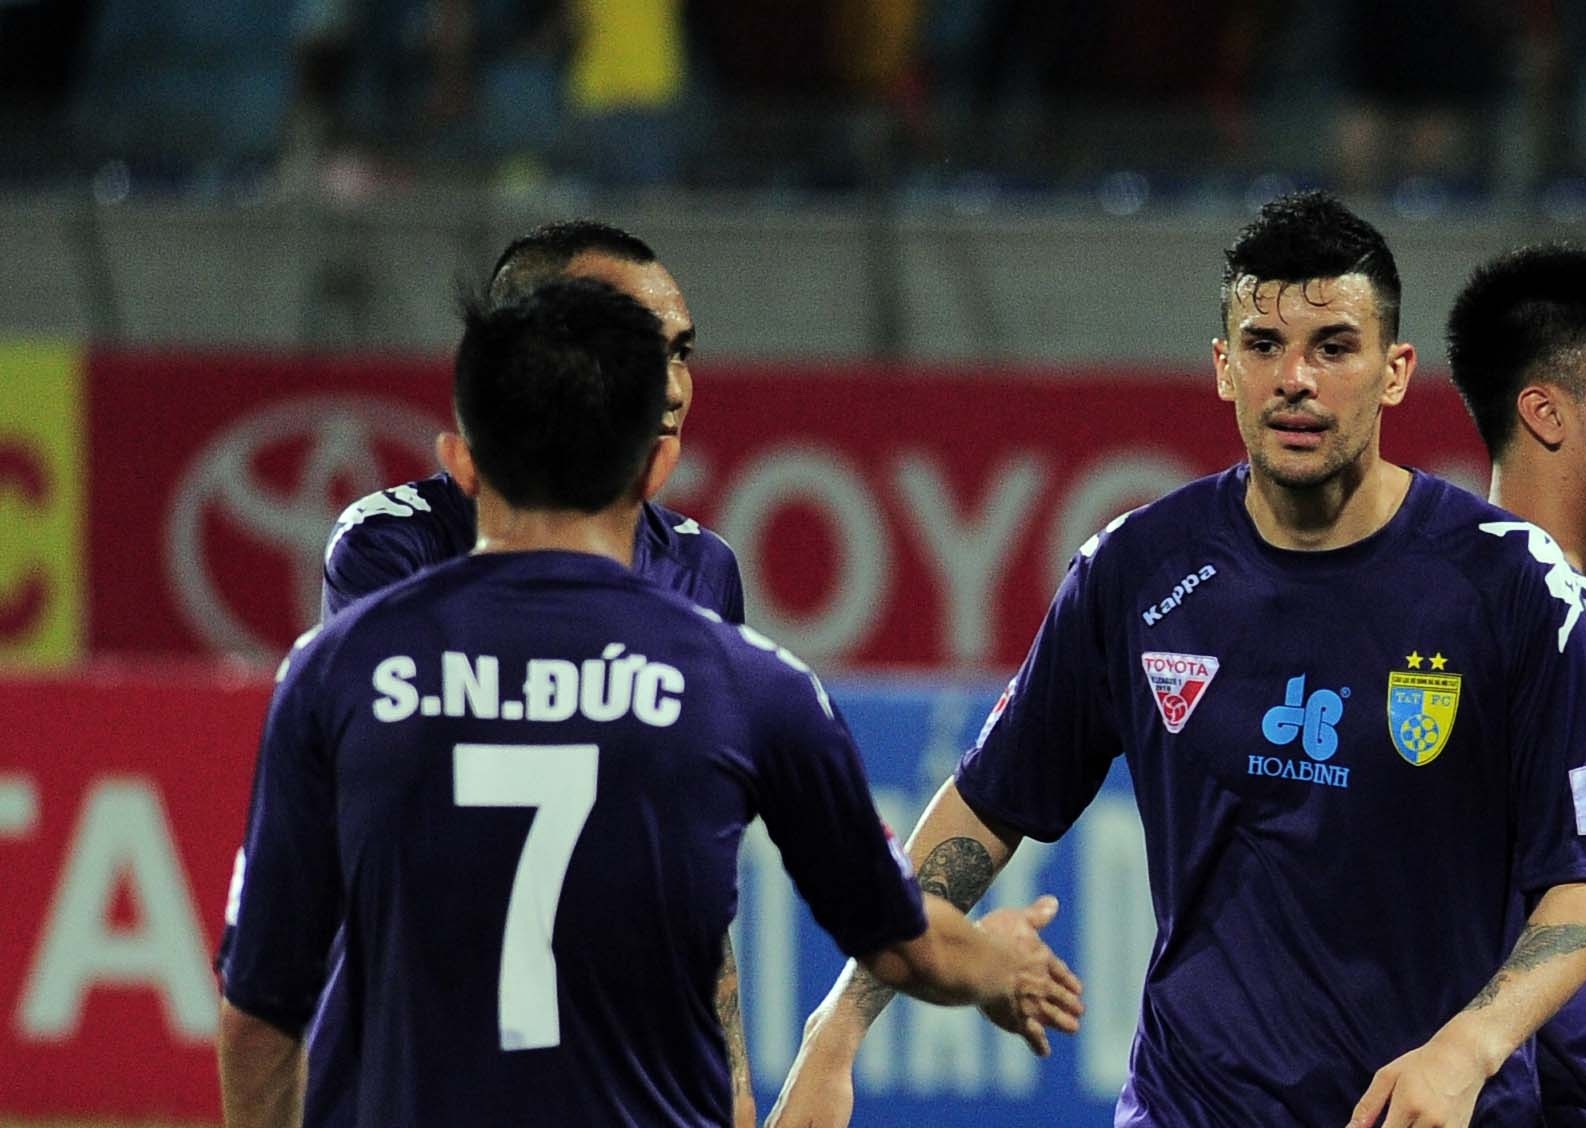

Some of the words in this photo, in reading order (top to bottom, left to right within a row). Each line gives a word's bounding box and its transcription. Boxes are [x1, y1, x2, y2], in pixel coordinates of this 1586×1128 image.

[1142, 564, 1217, 626] Kappa
[372, 643, 685, 727] S.N.ĐỨC
[1144, 658, 1209, 677] TOYOTA
[453, 744, 599, 1051] 7
